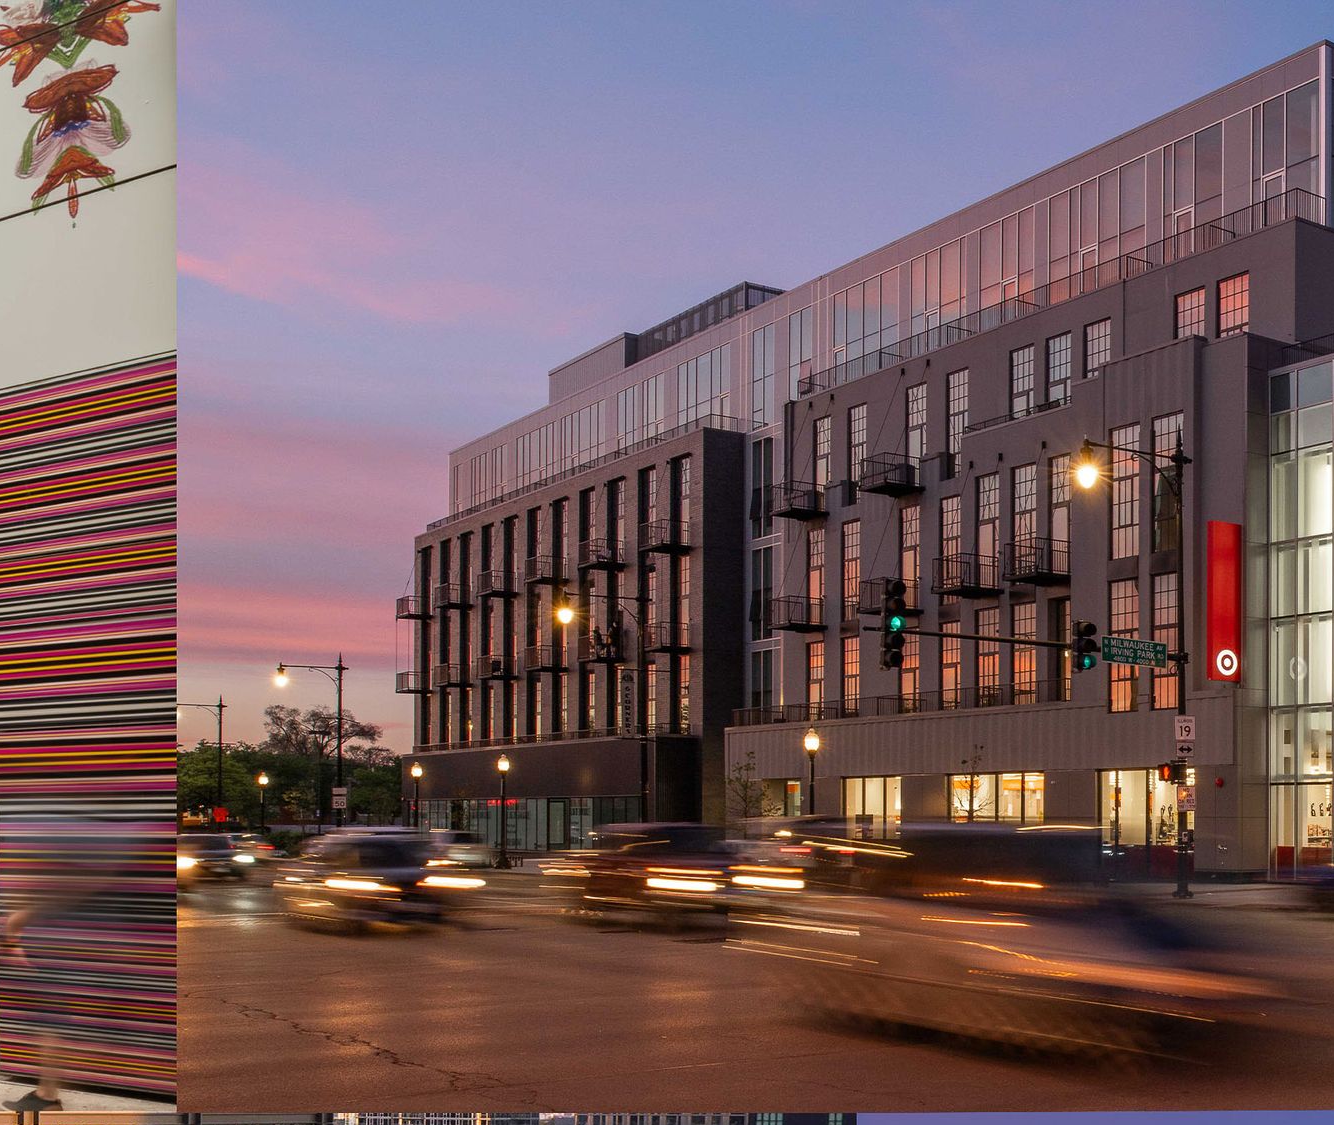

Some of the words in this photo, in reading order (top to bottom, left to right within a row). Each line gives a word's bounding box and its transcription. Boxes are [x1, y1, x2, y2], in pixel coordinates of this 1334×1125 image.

[1111, 639, 1154, 651] MILWAUKEE
[1111, 647, 1134, 657] IRVING
[1137, 650, 1155, 660] PARK
[1179, 725, 1191, 737] 19
